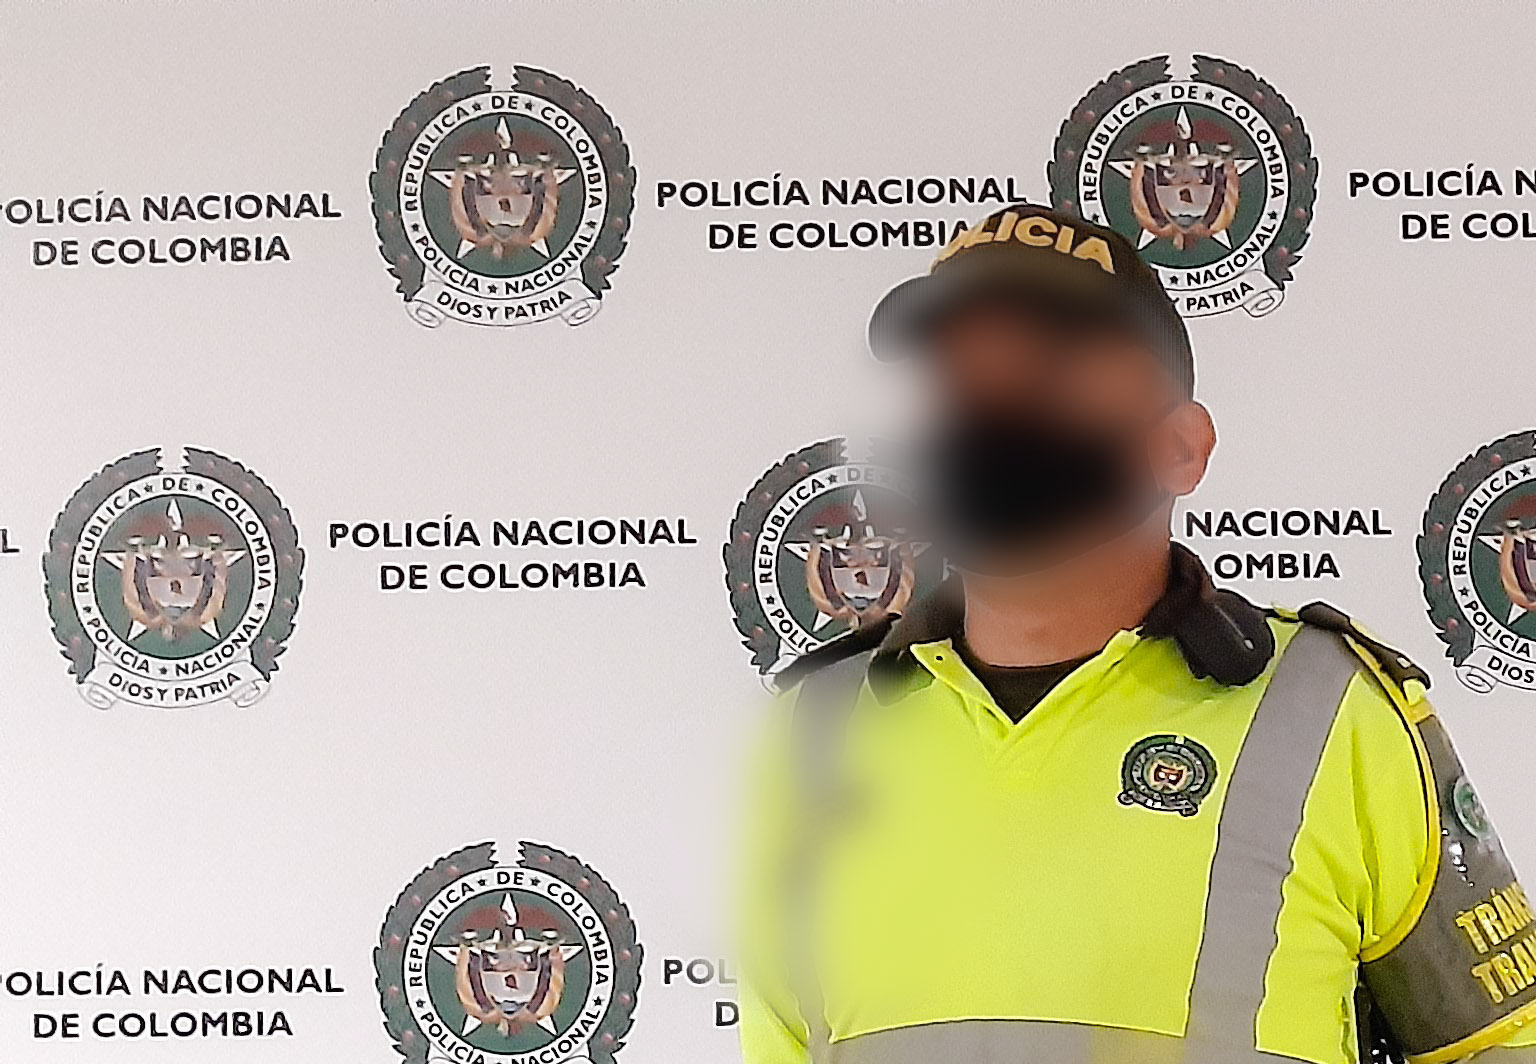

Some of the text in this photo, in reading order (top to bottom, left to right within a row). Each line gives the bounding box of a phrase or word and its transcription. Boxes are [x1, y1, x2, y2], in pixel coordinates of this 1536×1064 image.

[492, 95, 519, 109] DE
[541, 106, 602, 209] COLOMBIA
[658, 173, 1026, 207] POLICÍA NACIONAL
[1350, 163, 1502, 197] POLICÍA
[0, 191, 341, 224] OLICÍA NACIONAL
[709, 224, 757, 249] DE
[1402, 214, 1449, 239] DE
[33, 236, 290, 265] DE COLOMBIA
[930, 212, 1115, 274] LICIA
[506, 233, 593, 294] NACIONAL
[505, 290, 571, 320] PATRIA
[330, 514, 697, 548] POLICÍA NACIONAL
[1186, 510, 1392, 537] NACIONAL
[381, 563, 646, 589] DE COLOMBIA
[1215, 553, 1341, 580] OMBIA
[0, 963, 344, 996] OLICÍA NACIONAL
[34, 1011, 293, 1038] DE COLOMBIA
